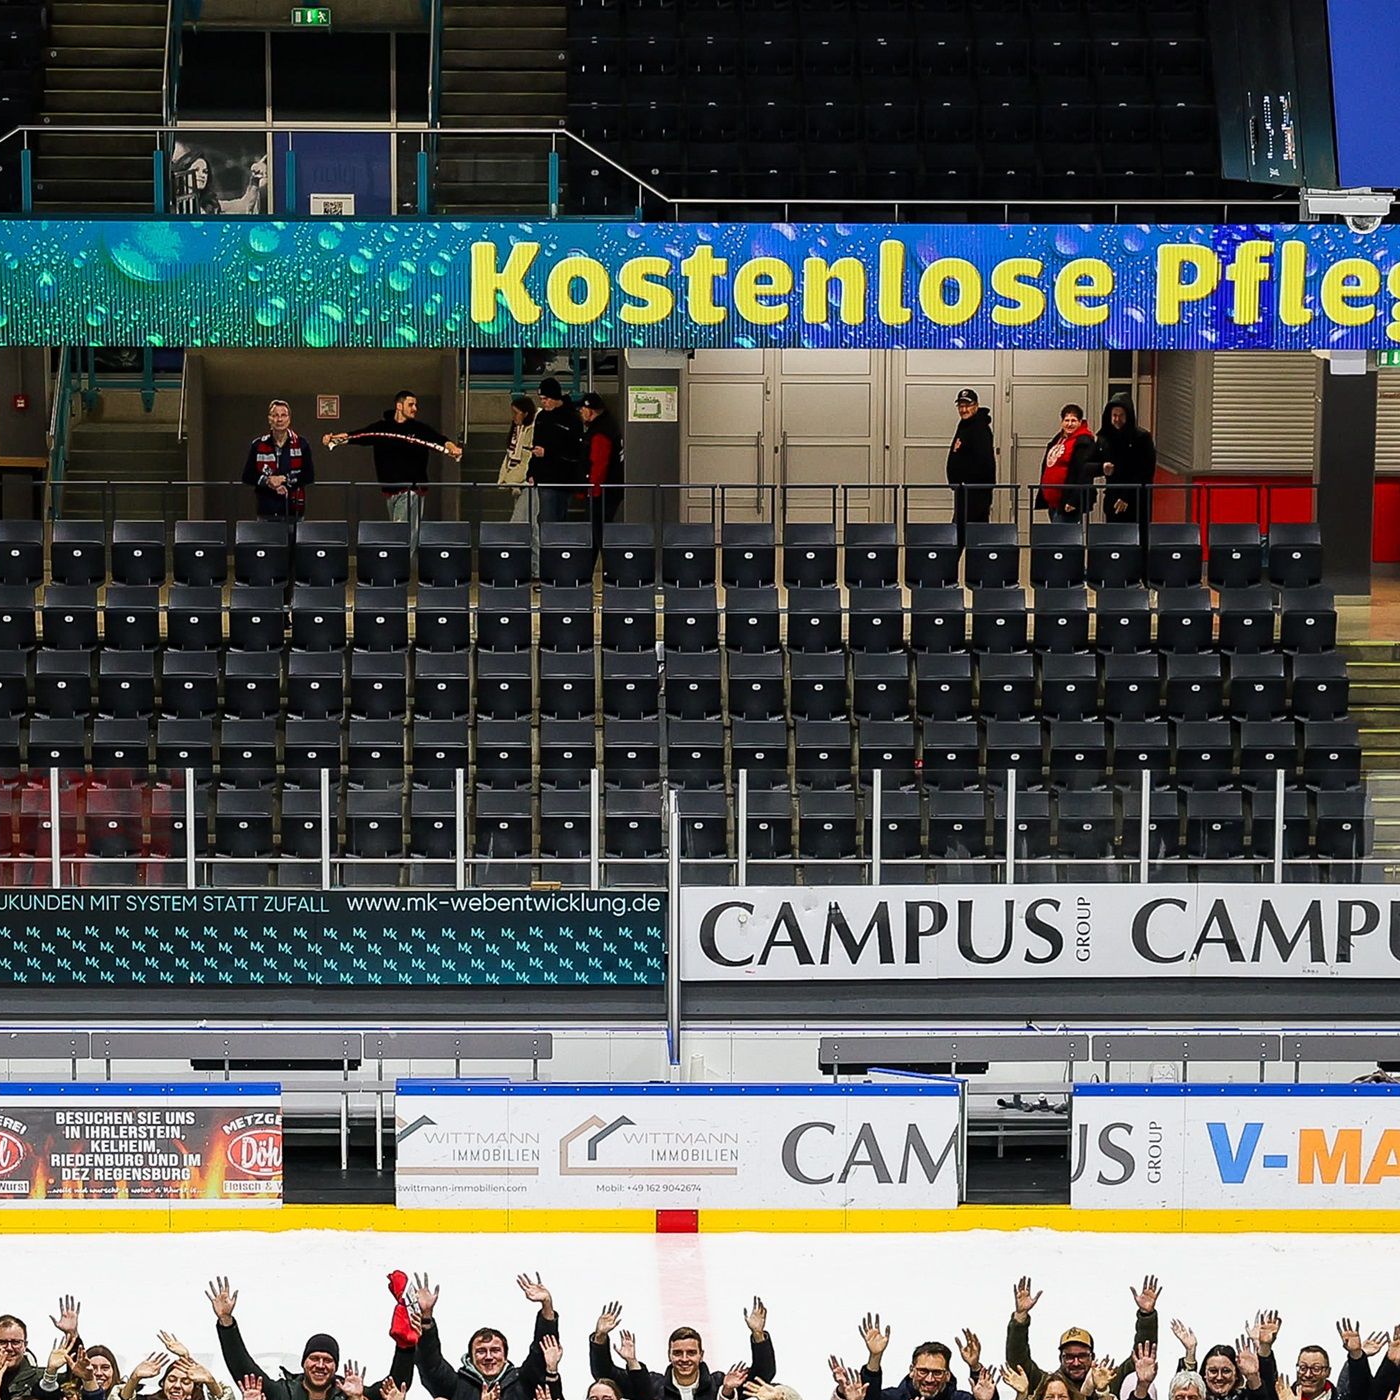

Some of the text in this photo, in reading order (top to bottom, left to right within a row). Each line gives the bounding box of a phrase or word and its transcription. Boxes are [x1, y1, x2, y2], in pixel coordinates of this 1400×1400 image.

[469, 241, 1113, 326] Kostenlose
[90, 895, 121, 912] MIT
[125, 895, 198, 912] SYSTEM
[202, 896, 259, 913] STATT
[264, 896, 330, 914] ZUFALL
[347, 893, 661, 917] www.mk-webentwicklung.de
[699, 899, 1065, 967] CAMPUS
[1076, 895, 1093, 963] GROUP
[55, 1111, 196, 1125] BESUCHEN SIE UNS
[65, 1125, 187, 1141] IN IHRLERSTEIN,
[425, 1132, 539, 1144] WITTMANN
[623, 1132, 739, 1144] WITTMANN
[90, 1140, 161, 1154] KELHEIM,
[1147, 1120, 1163, 1184] GROUP
[50, 1153, 202, 1167] RIEDENBURG UND IM
[452, 1149, 540, 1162] IMMOBILIEN
[651, 1149, 739, 1162] IMMOBILIEN
[61, 1167, 191, 1181] DEZ REGENSBURG
[224, 1181, 273, 1191] Fleisch &
[596, 1184, 701, 1192] Mobil: +49 162 9042674
